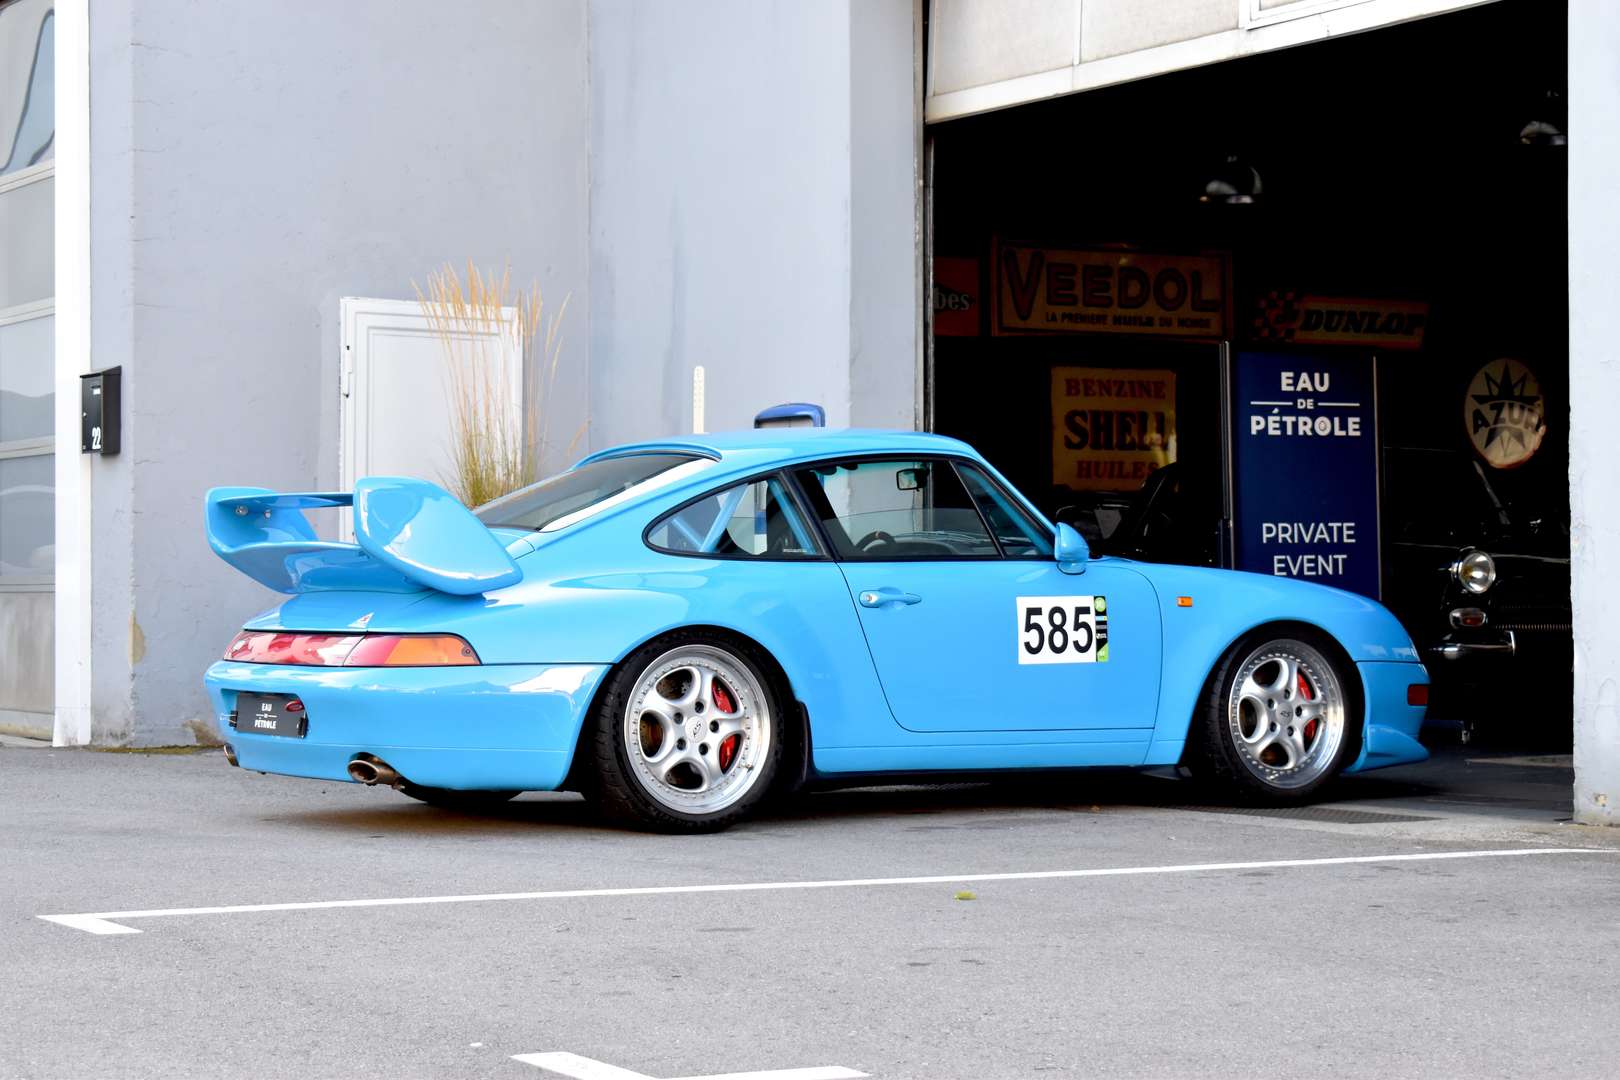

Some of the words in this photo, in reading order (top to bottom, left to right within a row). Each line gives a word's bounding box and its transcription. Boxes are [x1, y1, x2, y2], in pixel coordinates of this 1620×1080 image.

[1003, 248, 1220, 320] VEEDOL
[1301, 308, 1425, 336] DUNLOP
[1065, 378, 1166, 399] BENZINE
[1281, 371, 1330, 392] EAU
[1297, 399, 1314, 409] DE
[1250, 407, 1361, 436] PÉTROLE
[1473, 402, 1541, 434] AZUR
[92, 426, 101, 449] 22
[1064, 410, 1168, 451] SHELL
[1262, 522, 1356, 544] PRIVATE
[1273, 554, 1347, 576] EVENT
[1023, 606, 1093, 655] 585
[261, 703, 272, 712] EAU
